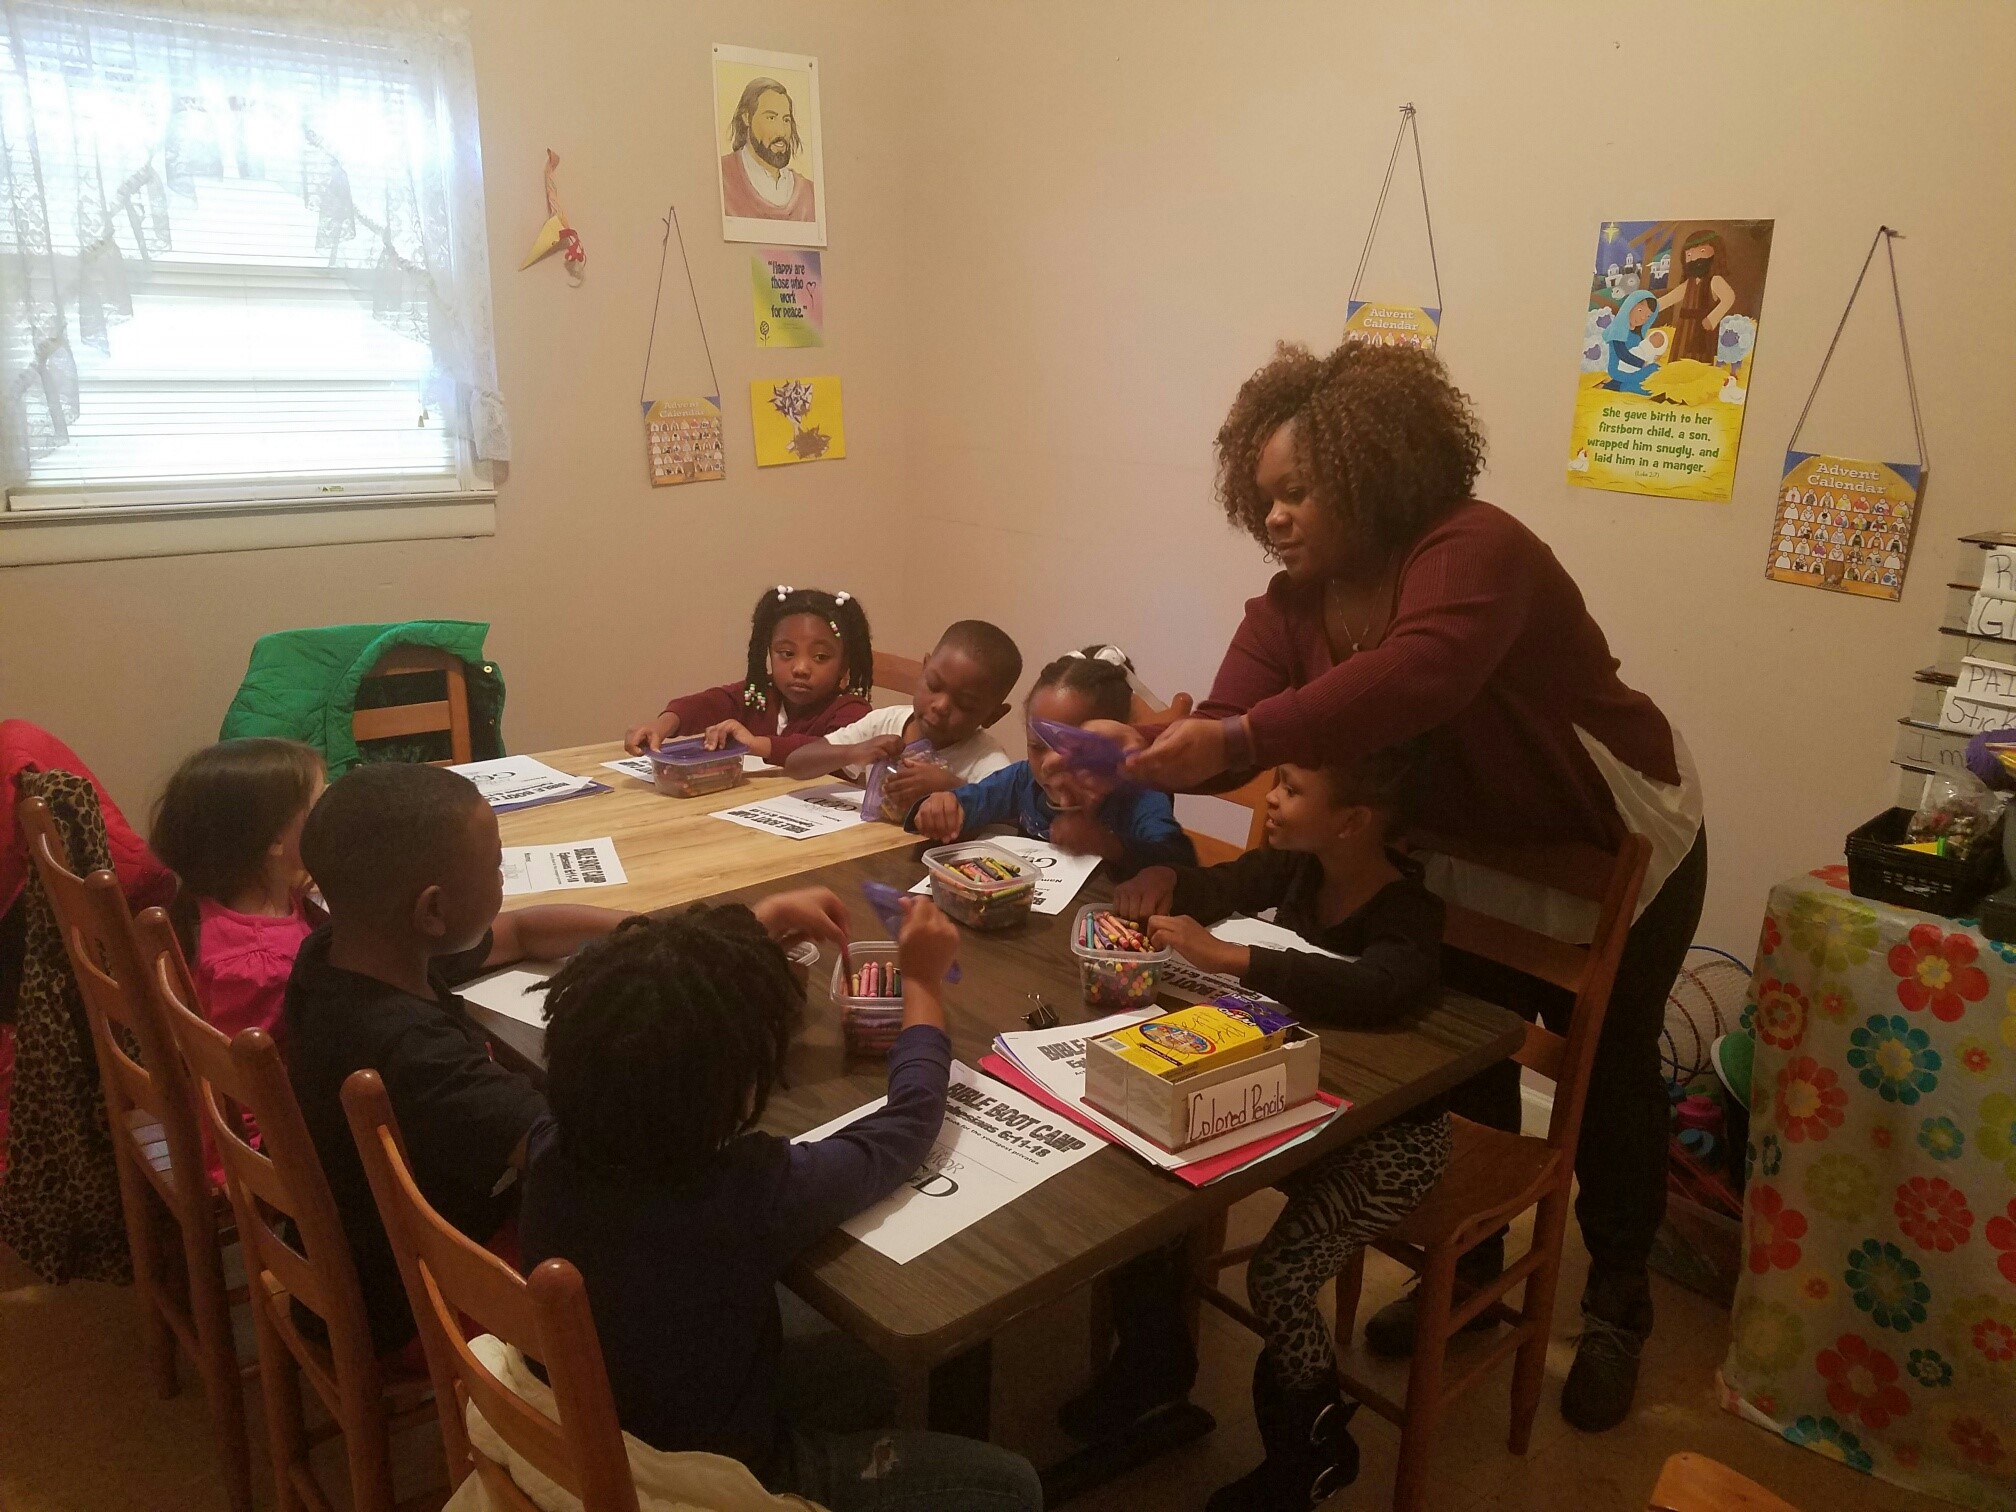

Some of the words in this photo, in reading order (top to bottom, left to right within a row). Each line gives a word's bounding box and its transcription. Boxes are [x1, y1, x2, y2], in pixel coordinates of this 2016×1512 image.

[794, 264, 805, 275] are
[771, 275, 790, 289] those
[790, 276, 804, 289] who
[779, 290, 796, 304] work
[771, 304, 781, 318] for
[1369, 308, 1415, 319] Advent
[1363, 318, 1419, 331] Calendar
[1602, 407, 1621, 418] She
[1624, 410, 1647, 422] gave
[1651, 411, 1676, 423] birth
[1681, 414, 1691, 424] to
[1695, 413, 1713, 425] her
[1599, 422, 1643, 436] firstborn
[1678, 431, 1685, 439] a
[1587, 438, 1629, 451] wrapped
[1632, 440, 1652, 452] him
[1699, 448, 1720, 458] and
[1594, 452, 1612, 464] laid
[1616, 453, 1635, 466] him
[1639, 457, 1649, 467] in
[1653, 459, 1659, 468] a
[1663, 462, 1706, 474] manger.
[1816, 462, 1880, 481] Advent
[1807, 474, 1887, 494] Calendar
[1189, 1088, 1247, 1141] Colored
[983, 1102, 1042, 1131] BOOT
[1028, 1124, 1087, 1153] CAMP
[971, 1129, 982, 1137] the
[982, 1135, 1012, 1152] youngest
[1011, 1150, 1040, 1165] privates
[998, 1130, 1051, 1158] 6:11-18
